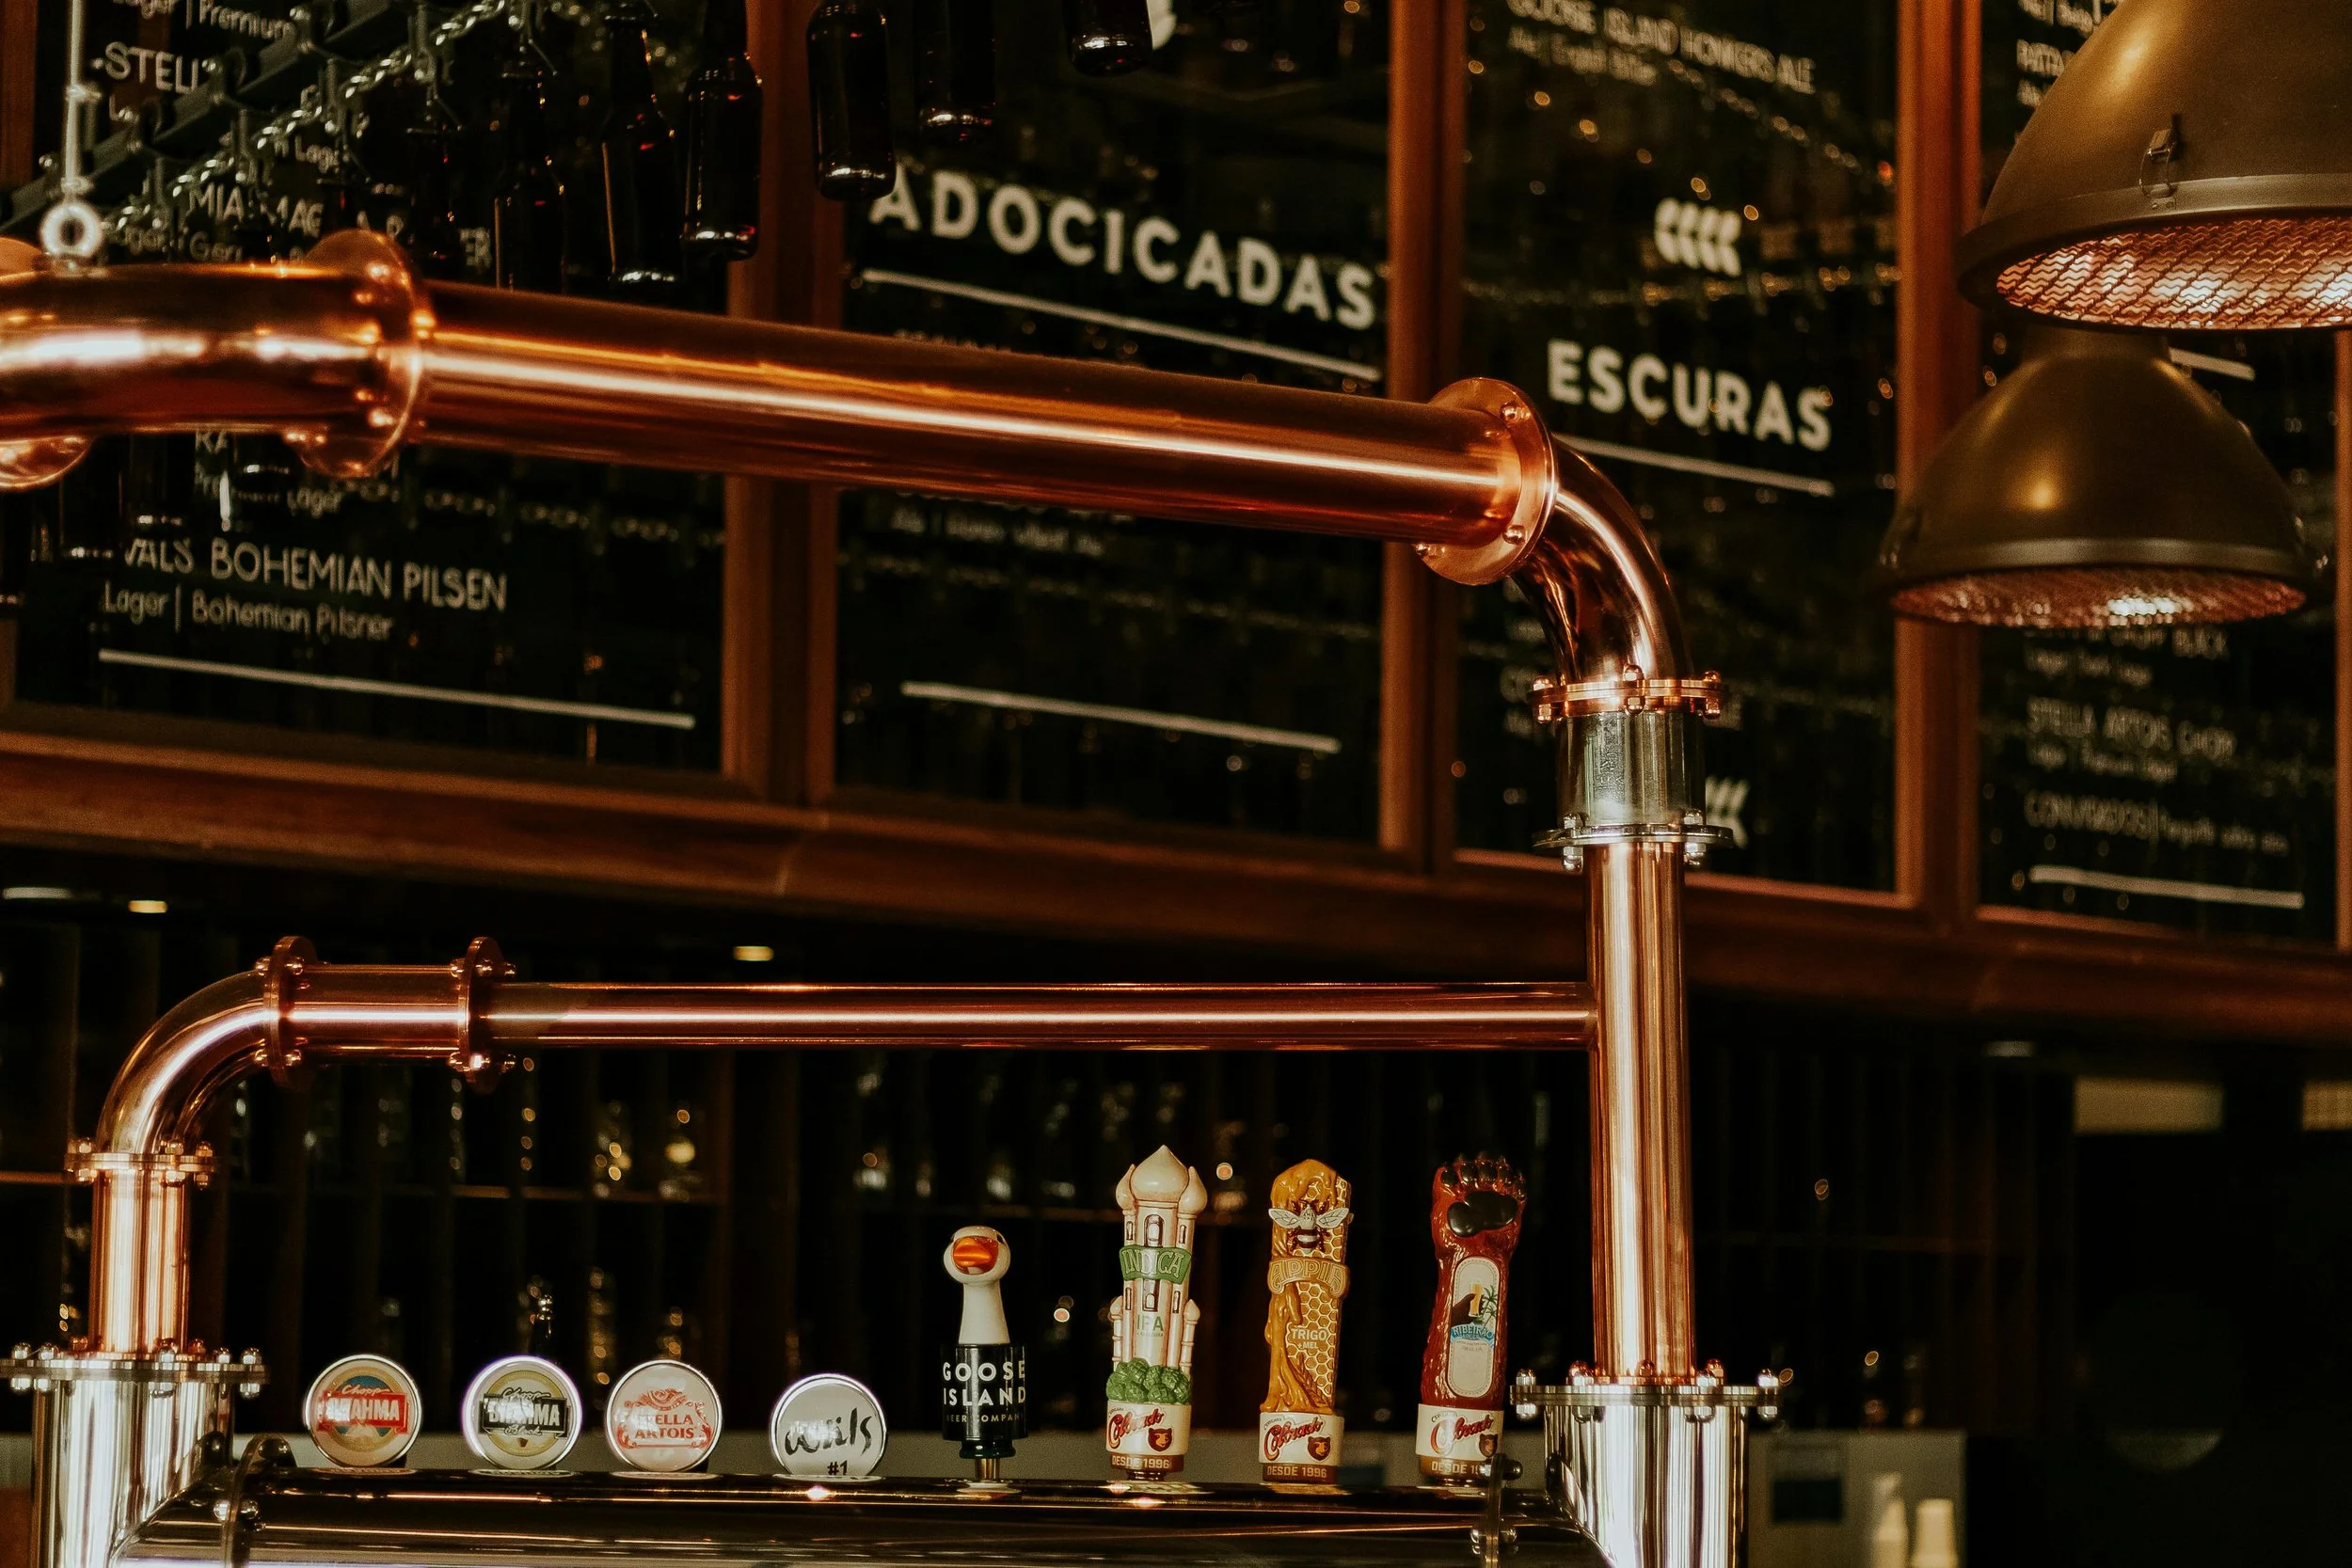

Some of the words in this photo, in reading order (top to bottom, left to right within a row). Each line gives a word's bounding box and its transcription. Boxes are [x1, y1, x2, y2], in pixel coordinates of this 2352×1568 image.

[103, 40, 200, 95] STELL
[866, 158, 1379, 330] ADOCICADAS
[1547, 337, 1833, 452] ESCURAS
[210, 536, 393, 602] BOHEMIAN
[402, 559, 508, 613] PILSEN
[102, 579, 170, 626] Lager
[190, 587, 312, 637] Bohemian
[1121, 1247, 1184, 1279] INDICA
[1270, 1259, 1346, 1293] APPIA
[1136, 1314, 1164, 1332] IPA
[1291, 1327, 1327, 1341] TRIGO
[943, 1360, 1025, 1382] GOOSE
[326, 1396, 400, 1423] AHMA
[943, 1386, 1026, 1406] ISLAND
[486, 1397, 562, 1427] BMA
[637, 1413, 694, 1426] ELLA
[975, 1412, 1025, 1422] OMPAN
[634, 1427, 695, 1439] ARTOIS
[1108, 1408, 1165, 1449] Colodo
[1263, 1417, 1324, 1461] Colorado
[1430, 1414, 1494, 1455] Clorado
[827, 1460, 848, 1476] #1
[1143, 1457, 1171, 1470] 1996
[1266, 1465, 1299, 1477] DESDE
[1301, 1465, 1327, 1479] 1996
[1431, 1461, 1468, 1476] DESDE
